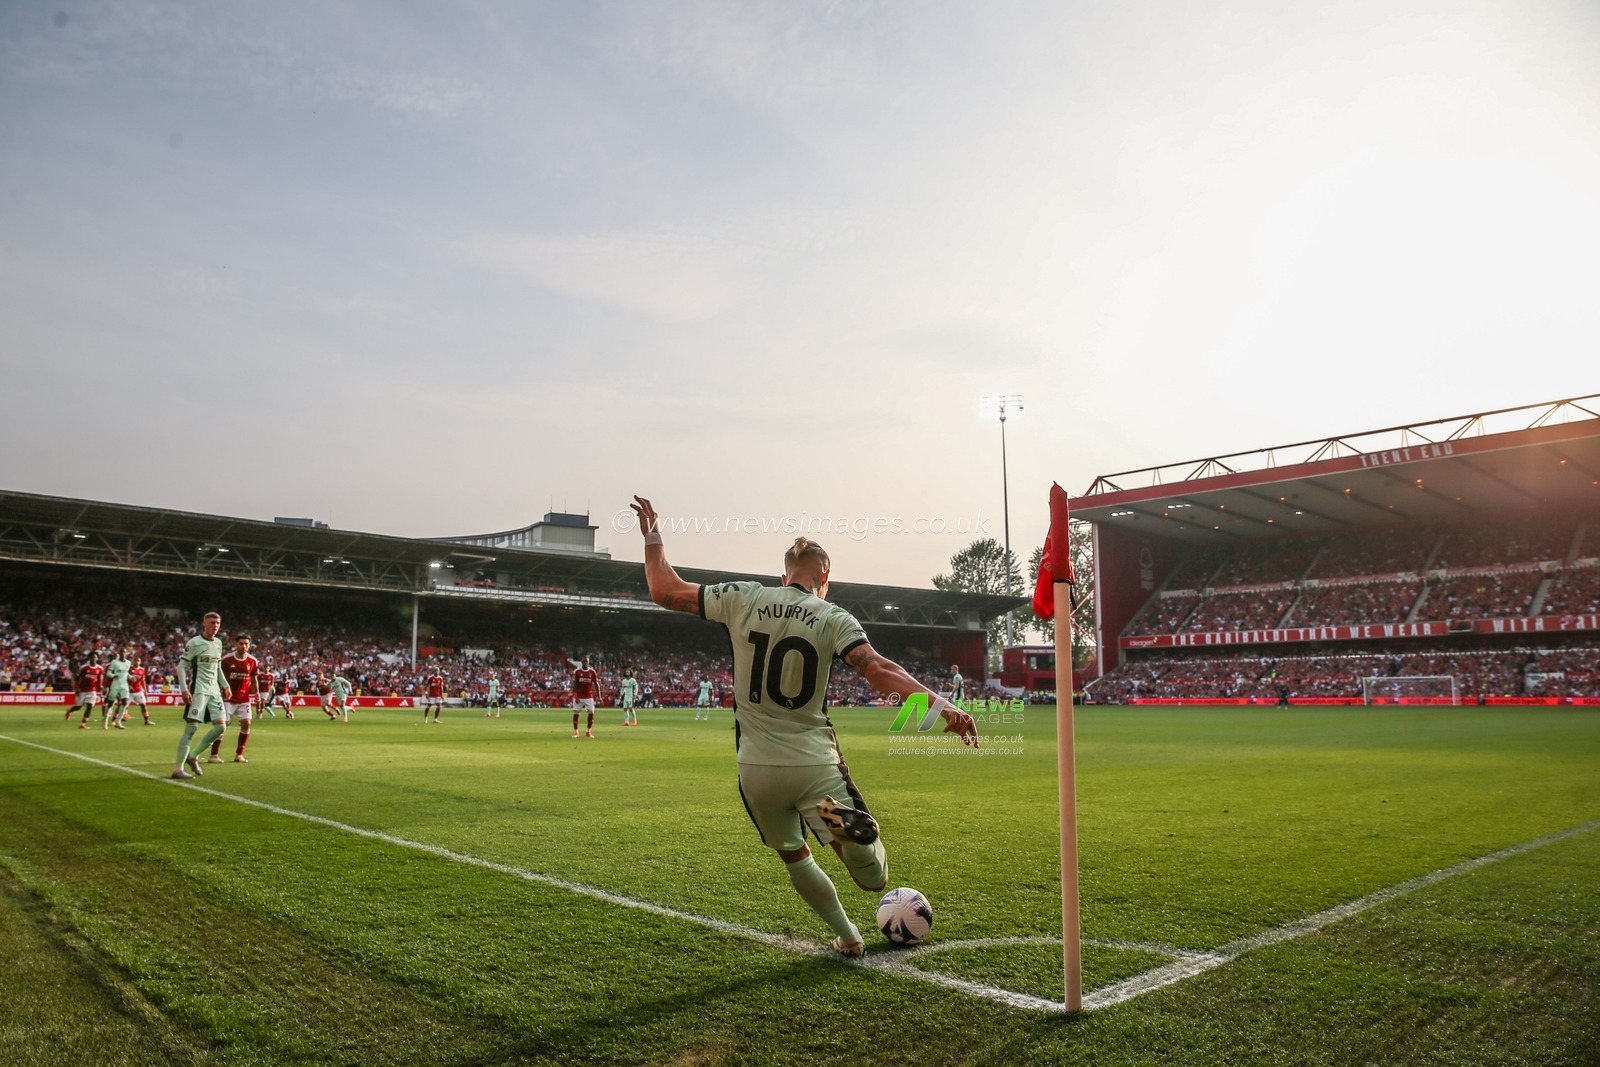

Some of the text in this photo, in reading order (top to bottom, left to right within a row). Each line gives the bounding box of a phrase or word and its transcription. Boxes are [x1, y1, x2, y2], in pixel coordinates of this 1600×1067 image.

[1360, 442, 1453, 467] TRENT END
[757, 603, 820, 630] MUDRYK
[1171, 634, 1195, 646] THE
[1205, 628, 1288, 645] GARIBALDI
[1299, 627, 1338, 640] THAT
[1350, 626, 1371, 639] WE
[1384, 623, 1432, 637] WEAR
[1493, 618, 1544, 632] WITH
[748, 630, 819, 710] 10
